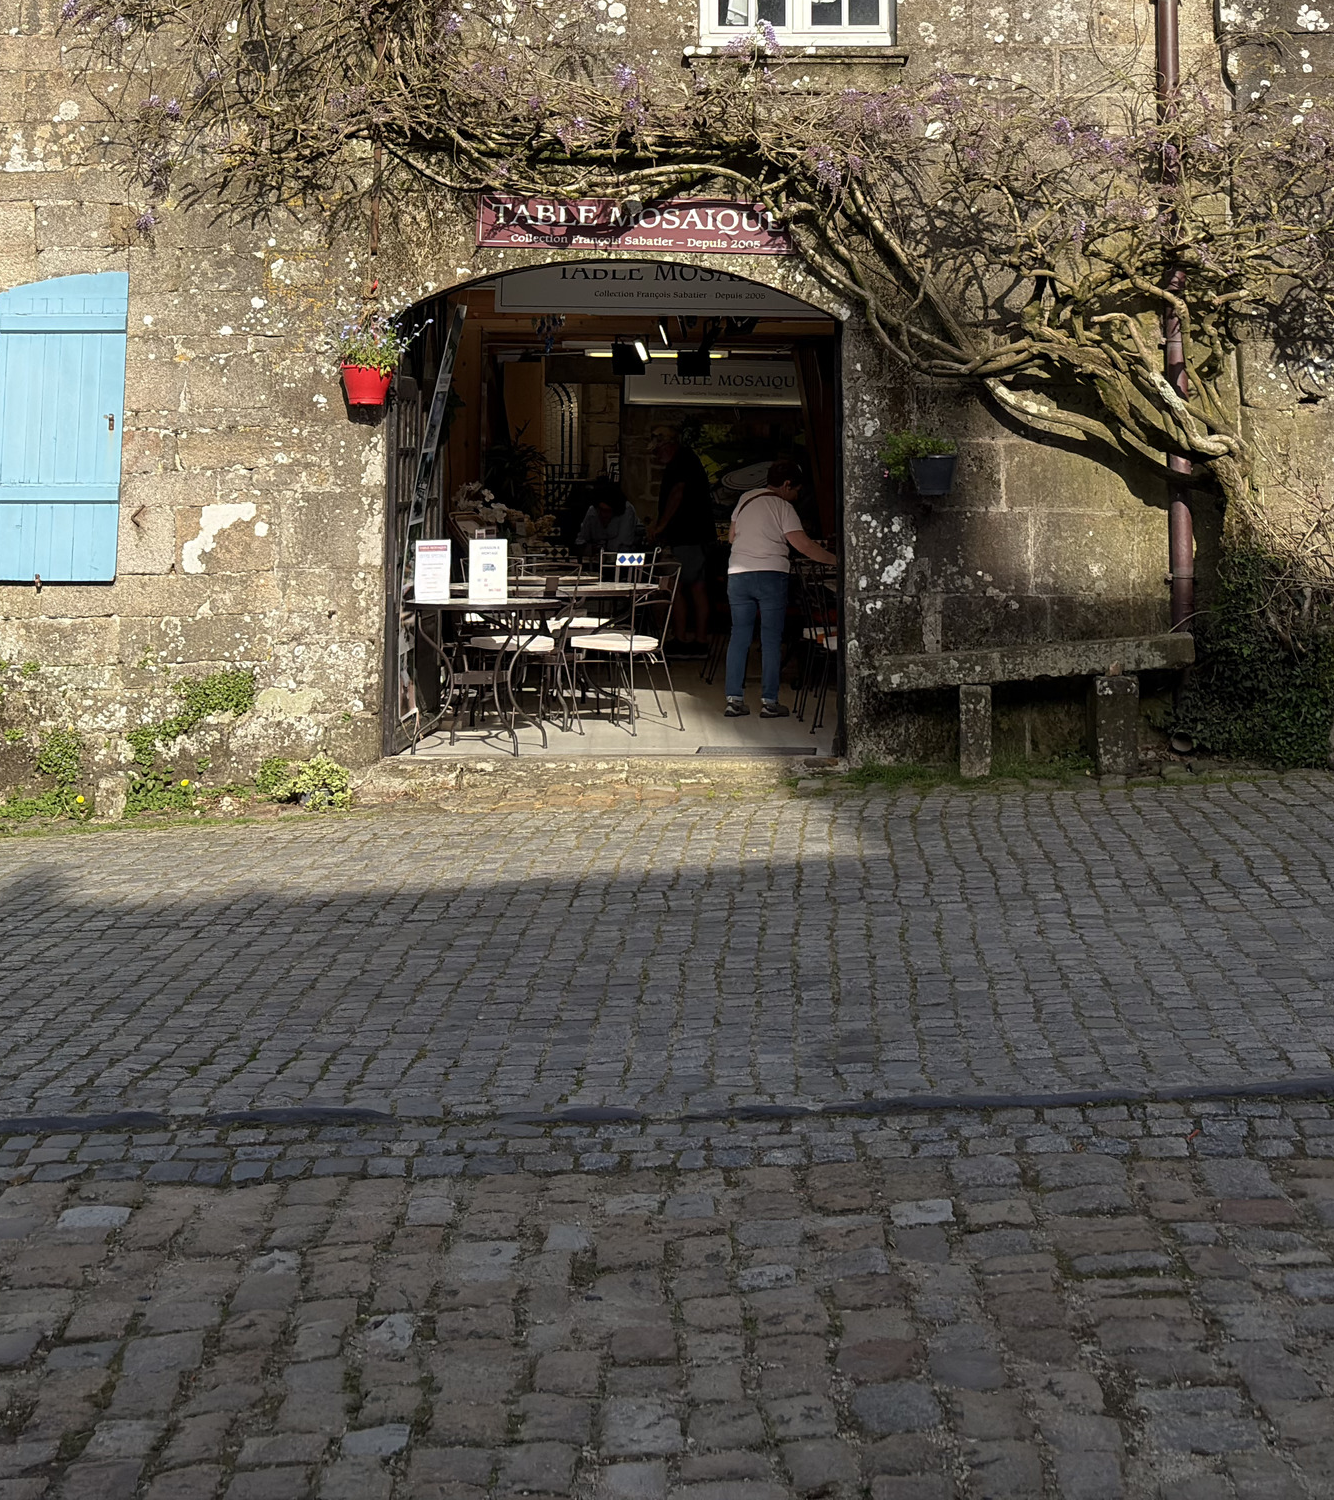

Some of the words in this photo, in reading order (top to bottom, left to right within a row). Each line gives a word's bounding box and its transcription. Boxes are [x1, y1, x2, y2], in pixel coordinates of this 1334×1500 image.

[491, 203, 598, 227] TABLE
[607, 204, 785, 235] MOSAIQUE
[510, 233, 568, 243] Collection
[572, 234, 621, 247] François
[624, 235, 674, 247] Sabatier
[687, 238, 727, 250] Depuis
[730, 239, 761, 249] 2005
[594, 290, 634, 298] Collection
[637, 290, 671, 299] François
[673, 291, 707, 299] Sabatier
[715, 292, 743, 300] Depuis
[745, 292, 766, 300] 2005
[660, 373, 712, 386] TABLE
[718, 375, 795, 390] MOSAIQU
